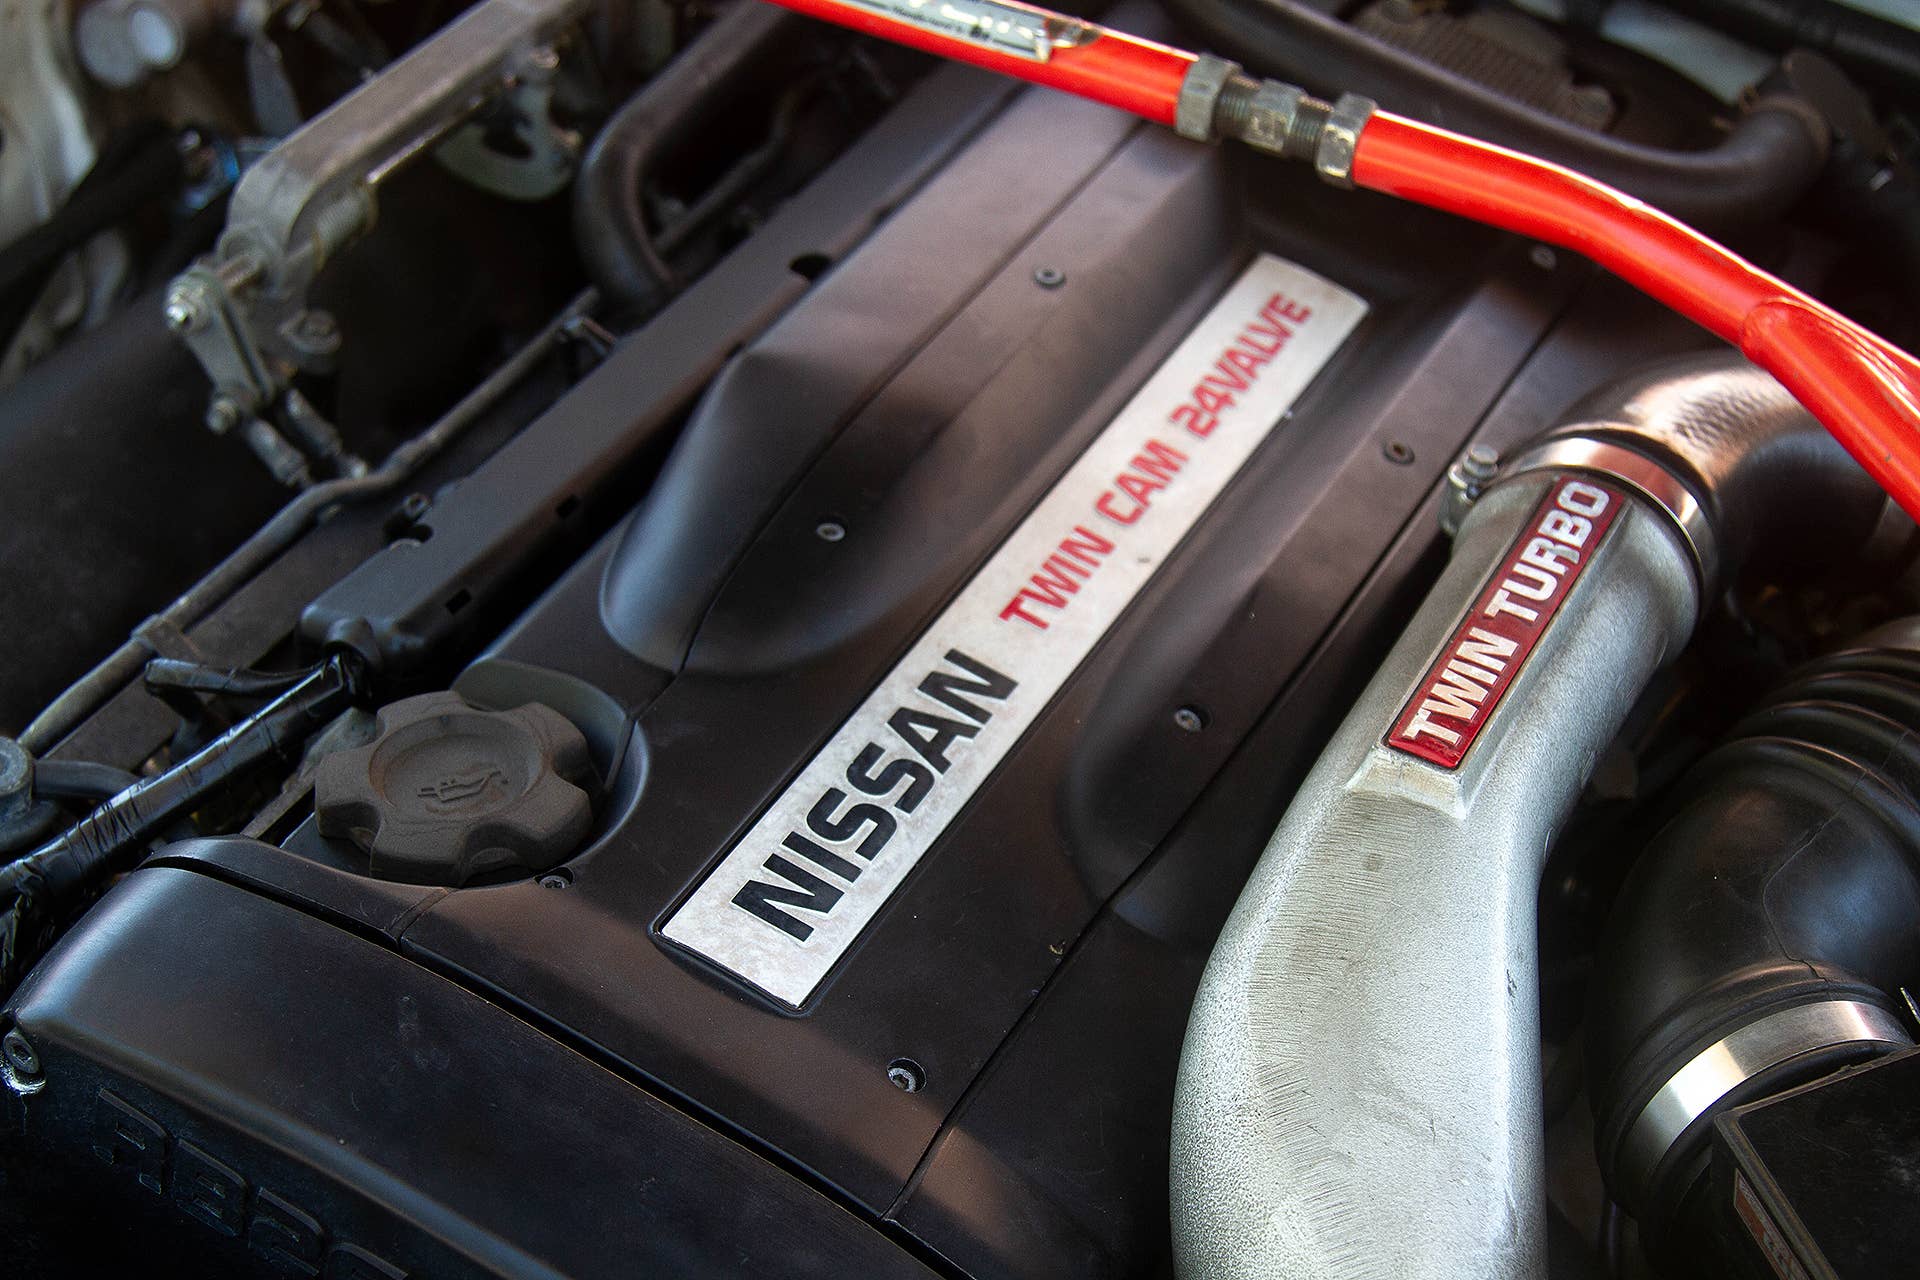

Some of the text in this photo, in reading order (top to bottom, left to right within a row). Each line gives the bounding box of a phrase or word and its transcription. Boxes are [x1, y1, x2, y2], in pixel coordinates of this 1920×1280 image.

[730, 292, 1313, 943] NISSAN TWIN CAM 24VALVE
[1402, 480, 1611, 746] TWIN TURBO
